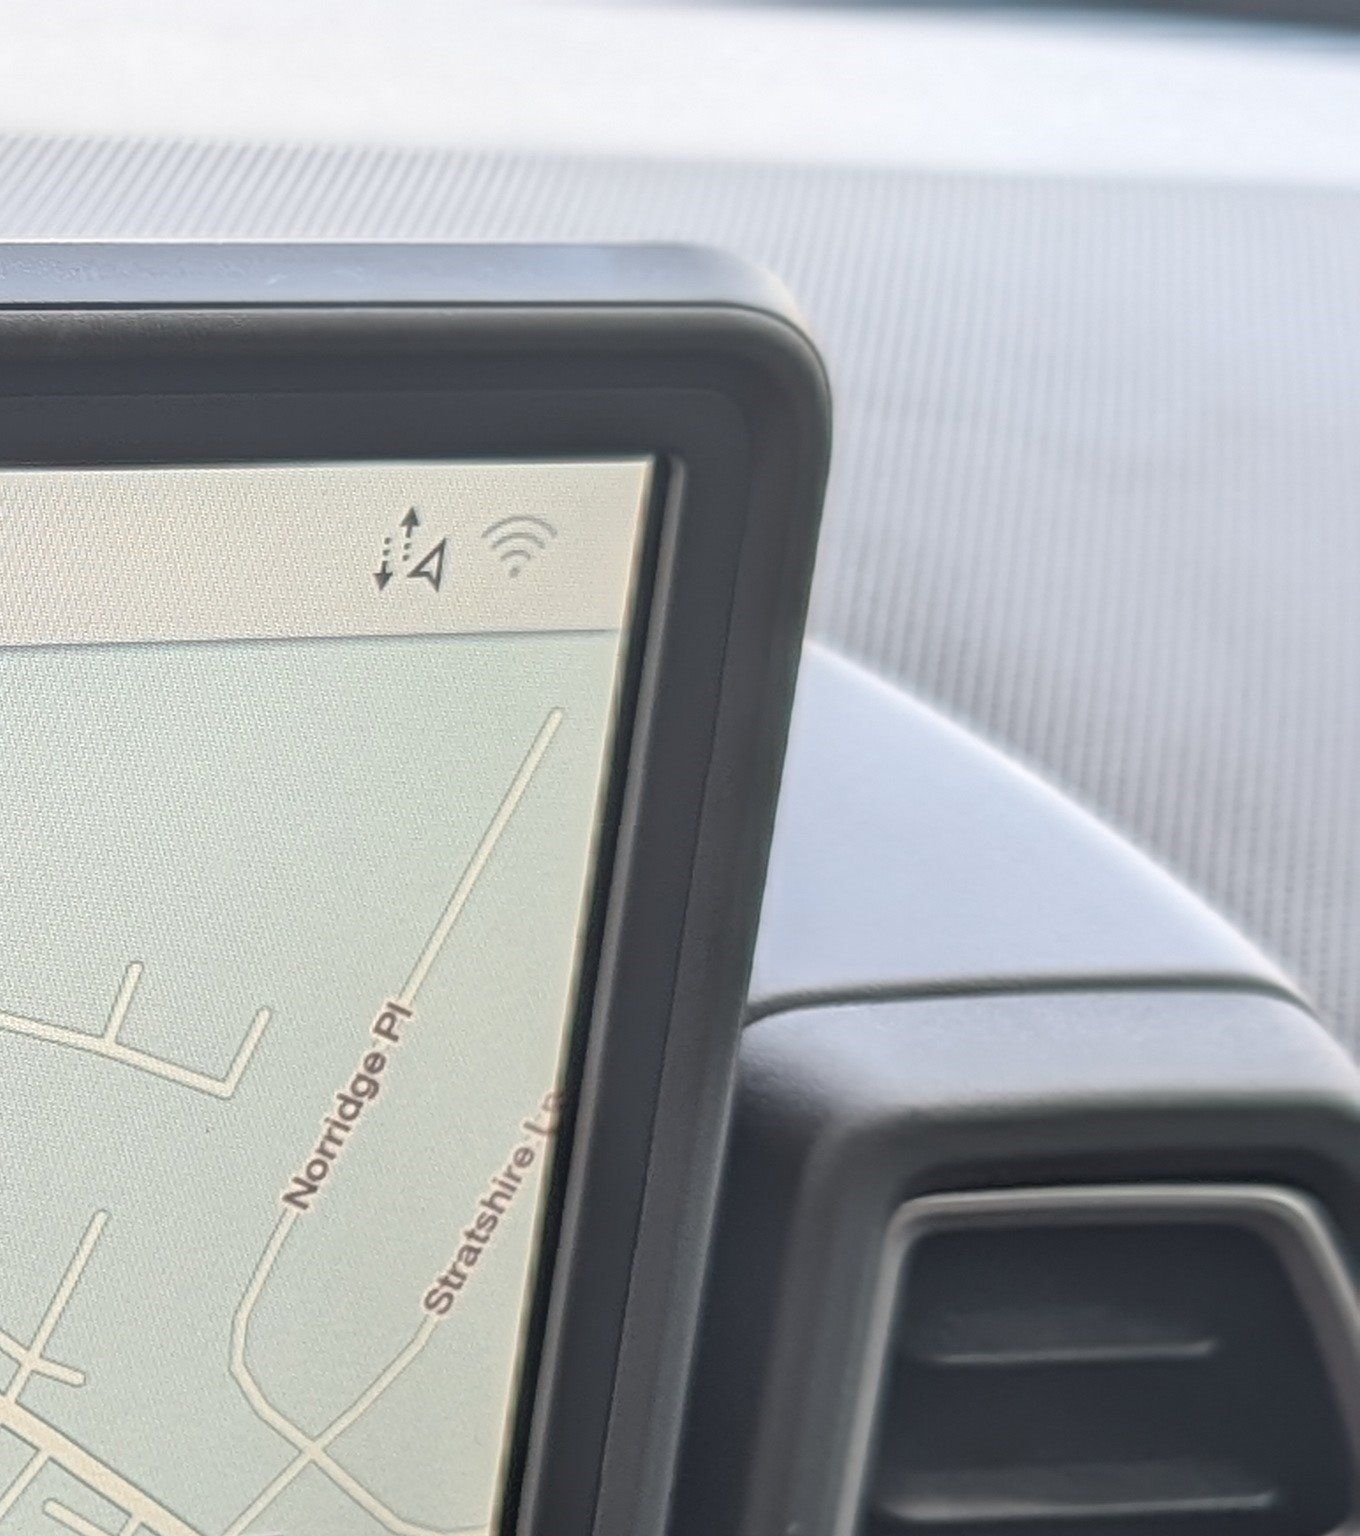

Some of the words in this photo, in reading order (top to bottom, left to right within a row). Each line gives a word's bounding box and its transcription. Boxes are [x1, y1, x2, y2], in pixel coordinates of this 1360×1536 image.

[282, 1052, 387, 1211] Norridge
[372, 1001, 413, 1043] Pl
[423, 1146, 536, 1316] Stratshire
